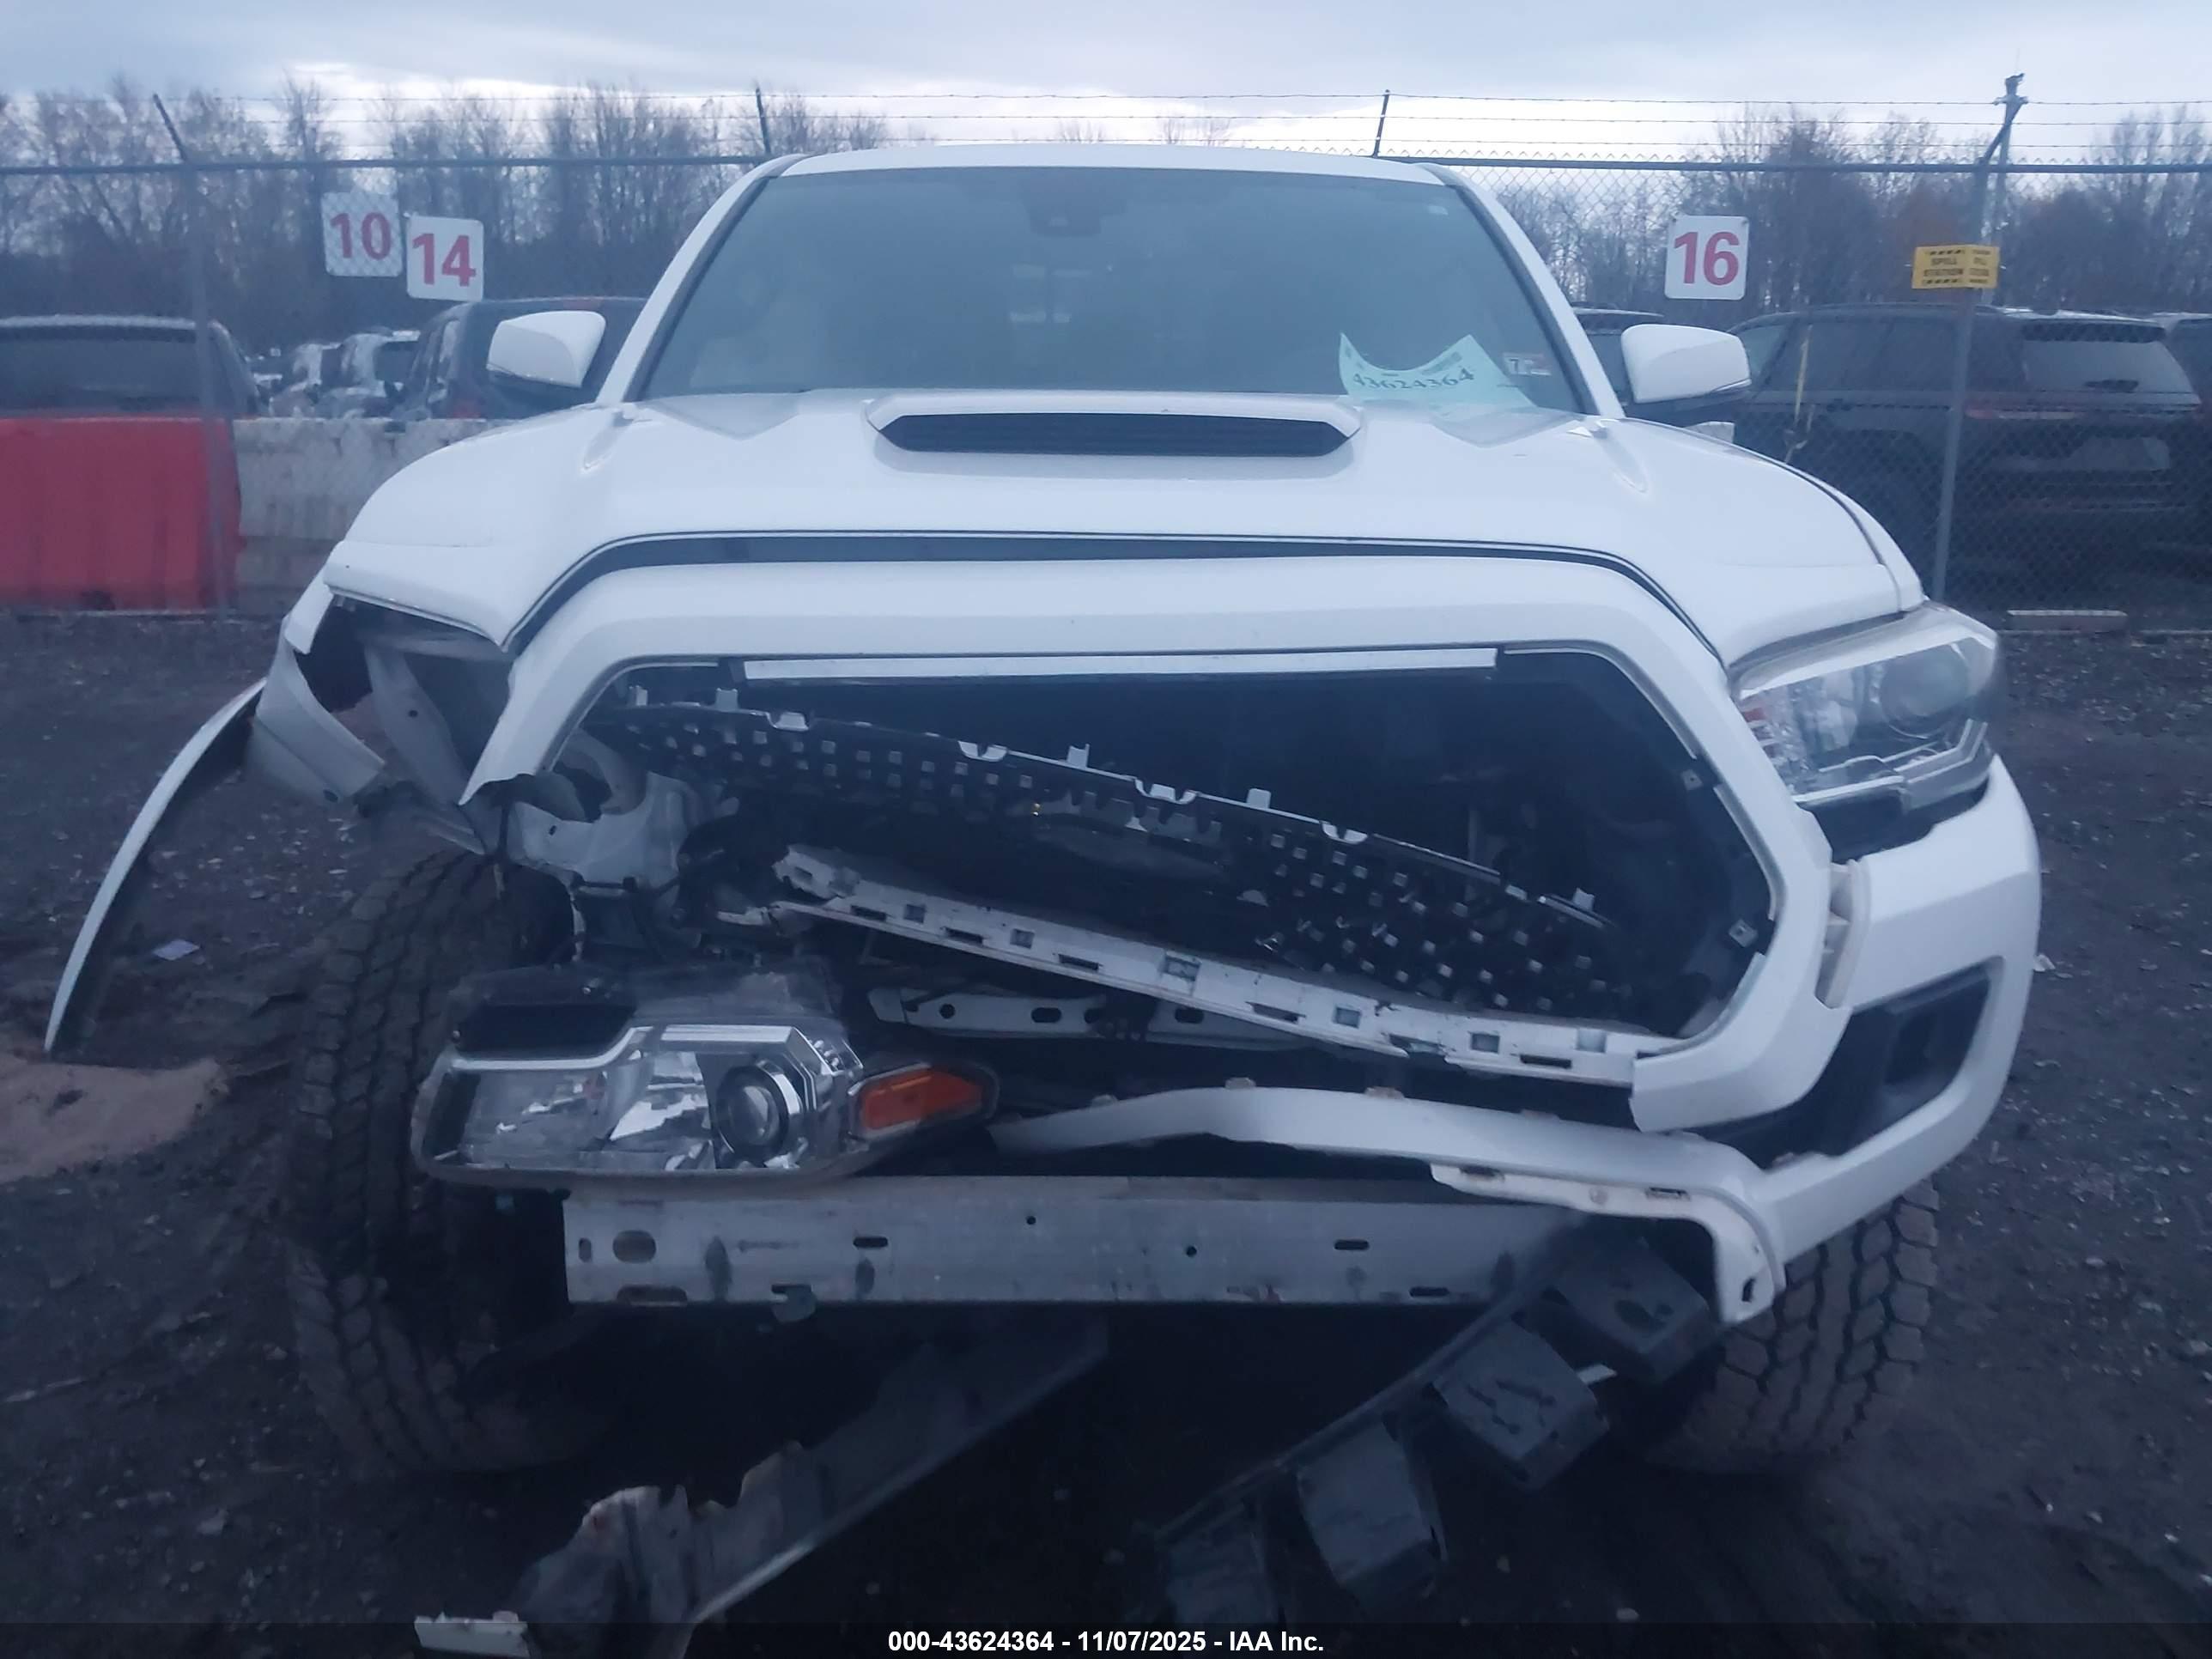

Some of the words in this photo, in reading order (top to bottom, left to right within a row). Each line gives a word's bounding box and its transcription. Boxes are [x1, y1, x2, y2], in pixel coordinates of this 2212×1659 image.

[330, 211, 392, 261] 10
[412, 233, 477, 288] 14
[1674, 231, 1740, 286] 16
[1352, 367, 1475, 389] 43624364
